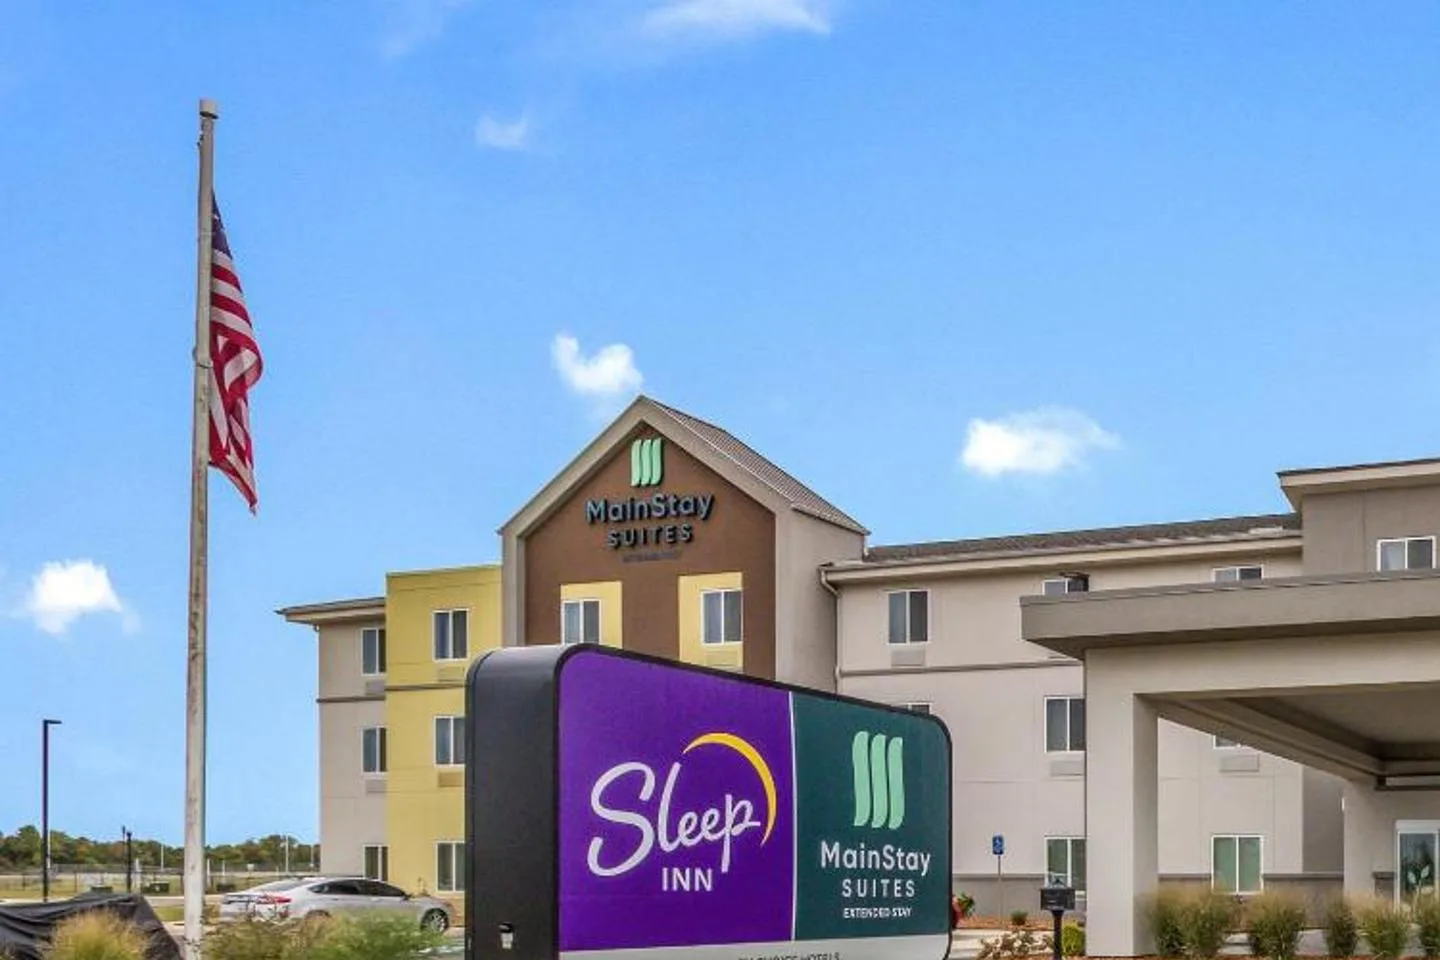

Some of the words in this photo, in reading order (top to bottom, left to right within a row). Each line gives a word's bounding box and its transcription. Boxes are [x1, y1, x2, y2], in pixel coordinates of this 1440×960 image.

[586, 493, 715, 524] MainStay
[608, 523, 693, 548] SUITES
[587, 761, 761, 876] Sleep
[821, 840, 931, 876] MainStay
[662, 867, 713, 891] INN
[842, 879, 915, 897] SUITES
[843, 907, 890, 918] EXTENDED
[892, 907, 912, 917] STAY
